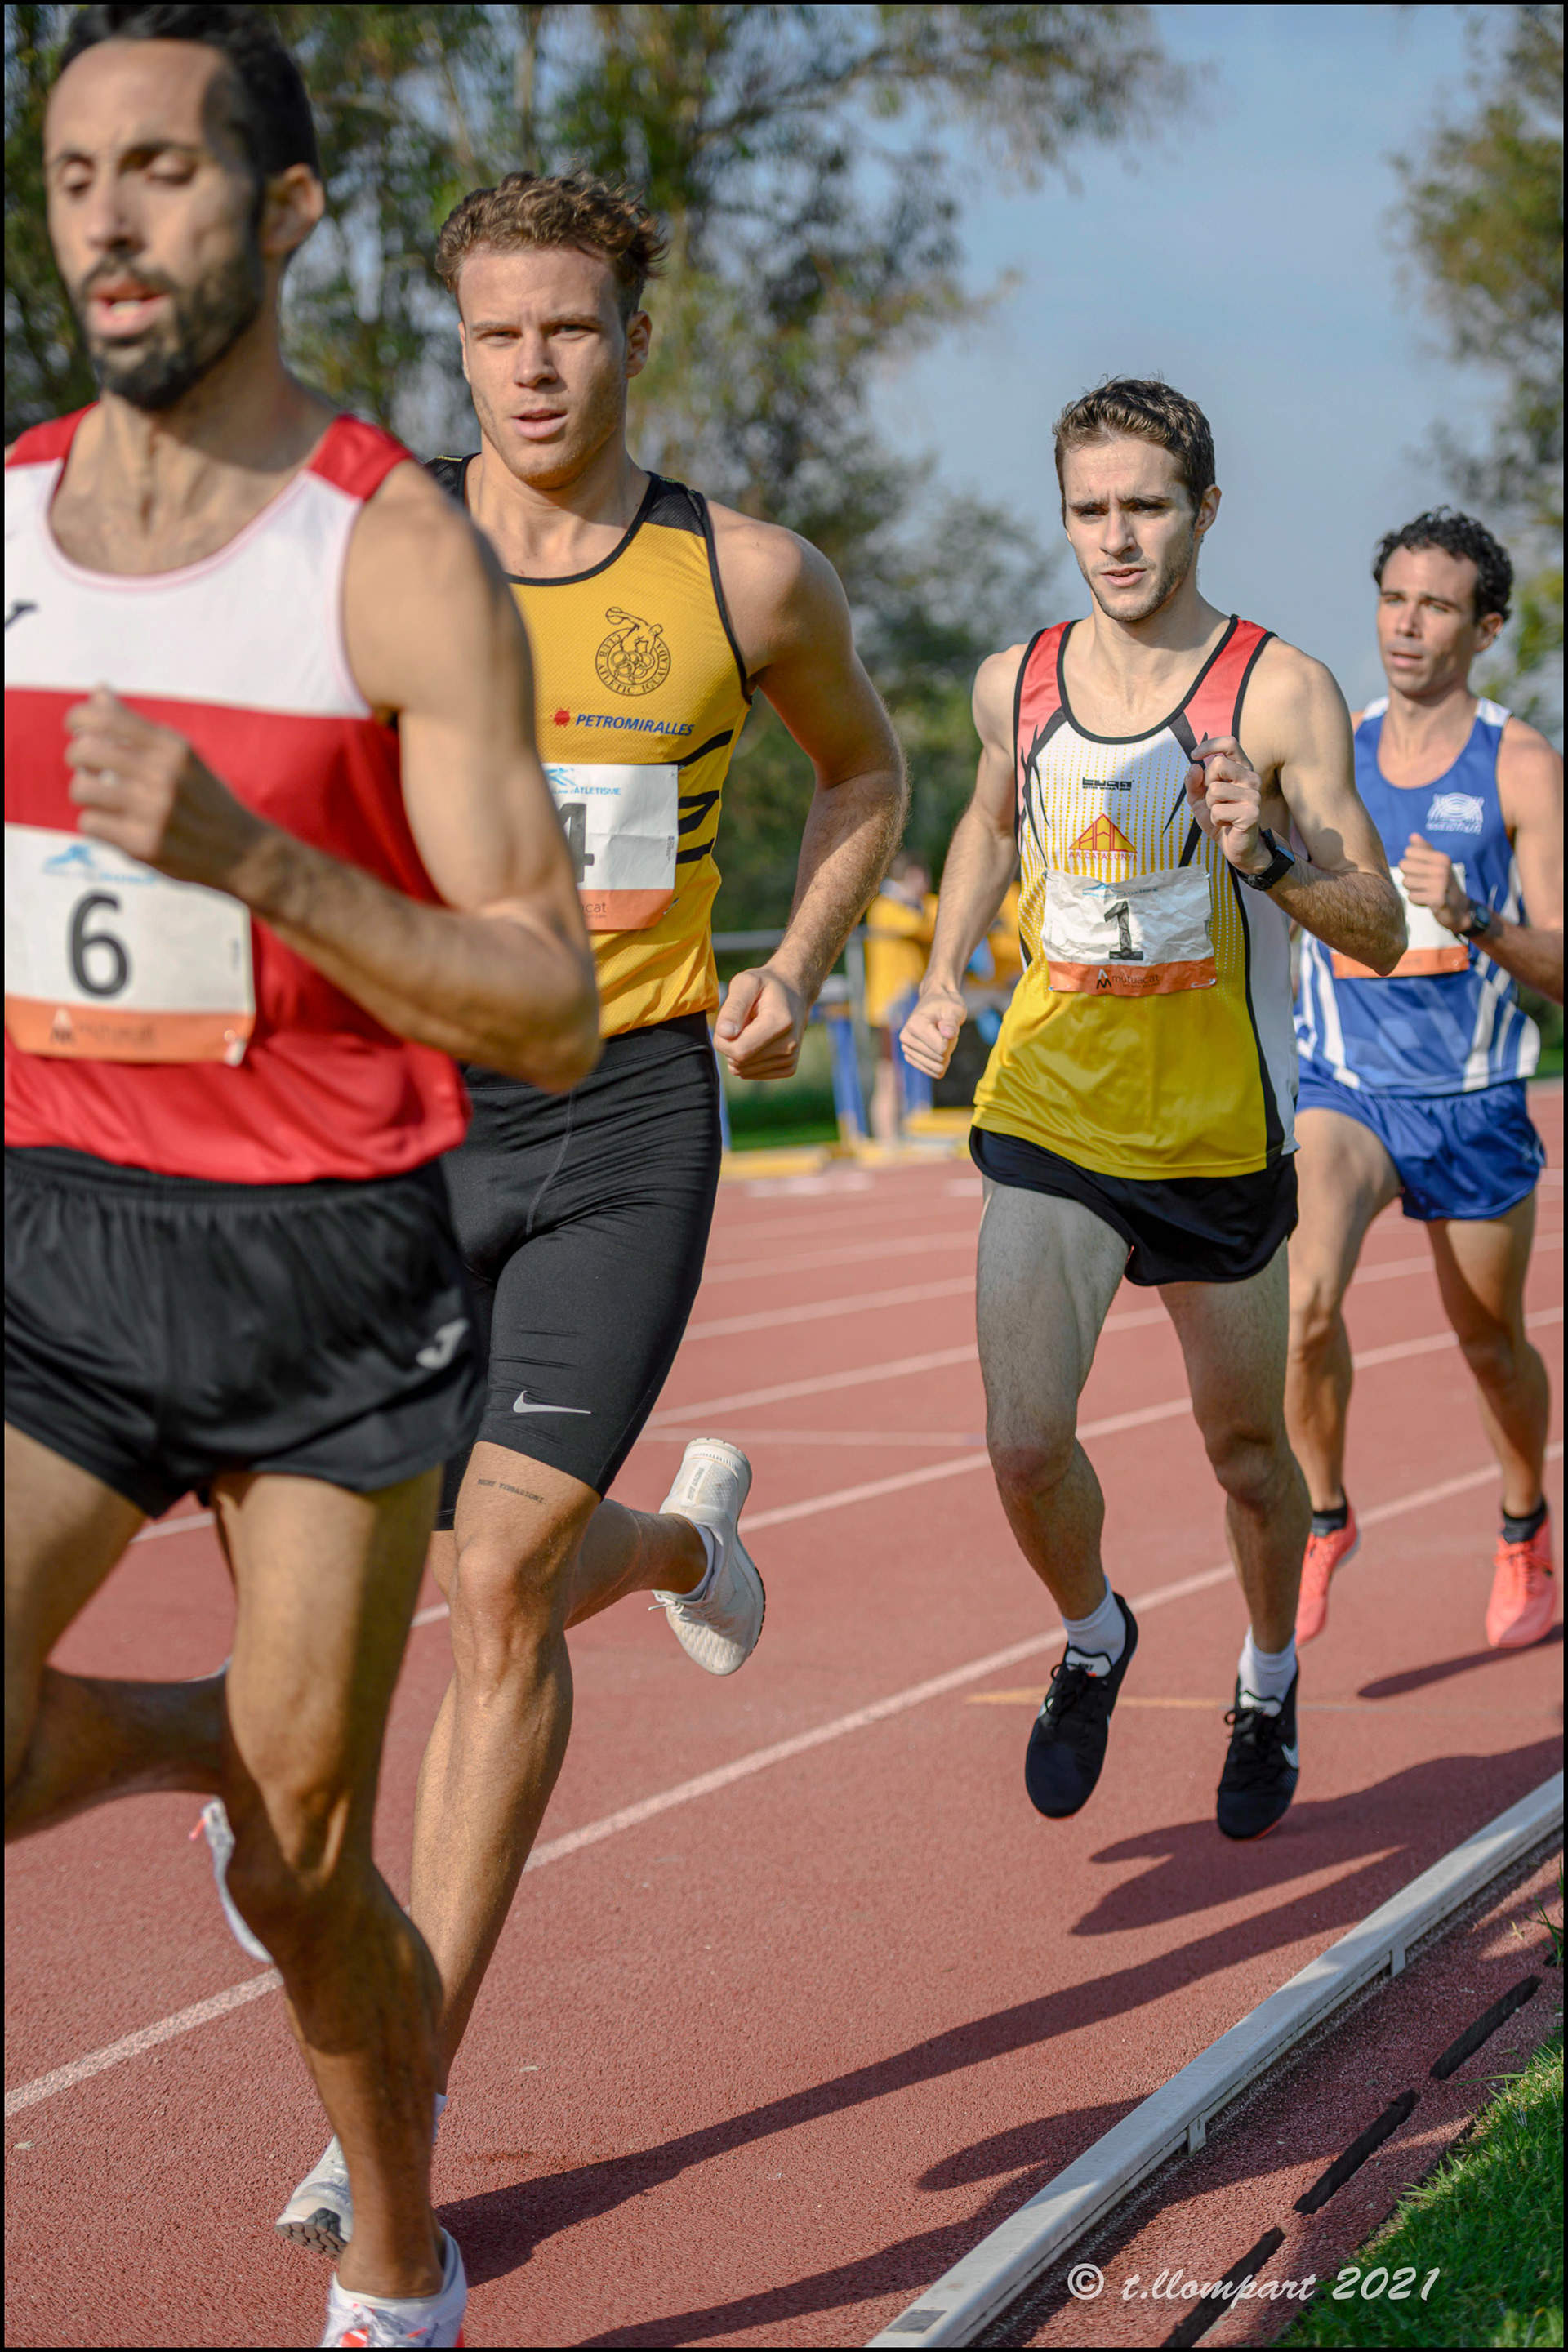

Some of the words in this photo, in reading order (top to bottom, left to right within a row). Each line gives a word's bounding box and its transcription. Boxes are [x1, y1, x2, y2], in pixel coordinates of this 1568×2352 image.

[575, 714, 694, 736] PETROMIRALLES
[557, 802, 595, 884] 4
[1084, 852, 1137, 862] CATALUNYA
[69, 890, 129, 998] 6
[1104, 901, 1143, 961] 1
